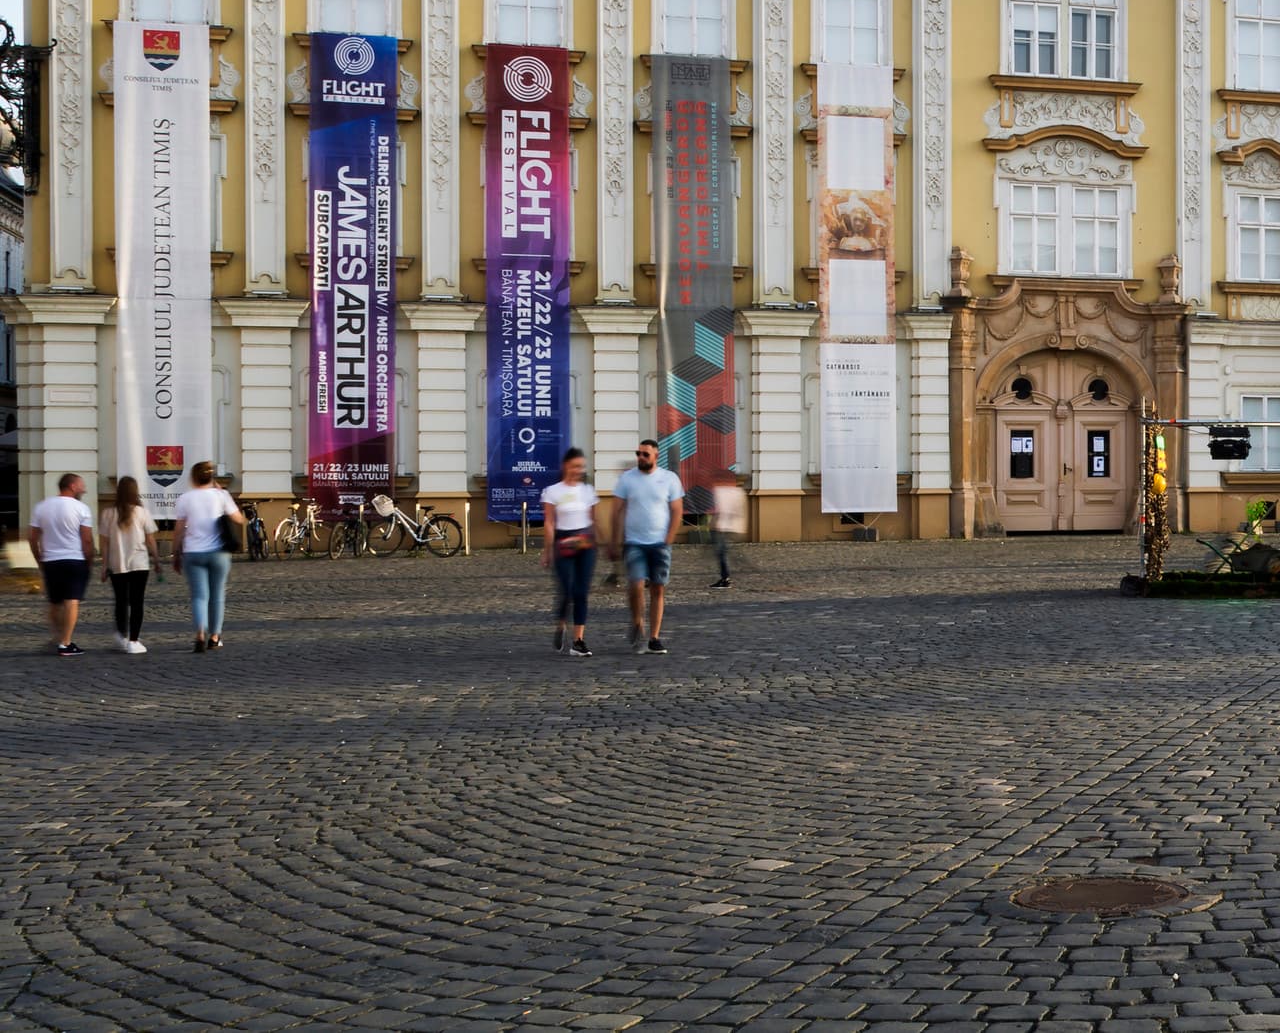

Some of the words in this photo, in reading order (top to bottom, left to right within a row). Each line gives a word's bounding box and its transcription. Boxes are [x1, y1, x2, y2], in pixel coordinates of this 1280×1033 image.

[123, 75, 161, 84] CONSILIUL
[322, 79, 386, 96] FLIGHT
[154, 118, 176, 179] TIMIȘ
[378, 136, 389, 185] DELIRIC
[503, 115, 514, 231] FESTIVAL
[520, 110, 552, 239] FLIGHT
[337, 166, 367, 281] JAMES
[378, 188, 388, 198] X
[378, 199, 388, 241] SILENT
[676, 101, 692, 305] NEOAVANGARDA
[154, 185, 176, 297] JUDEȚEAN
[377, 245, 388, 287] STRIKE
[376, 293, 388, 313] W/
[499, 269, 515, 335] BĂNĂȚEAN
[517, 270, 531, 339] MUZEUL
[533, 271, 553, 359] 21/22/23
[155, 303, 174, 419] CONSILIUL
[336, 286, 366, 426] ARTHUR
[376, 316, 388, 351] MUSE
[318, 351, 327, 382] MARIO
[318, 383, 327, 411] FRESH
[376, 354, 388, 432] ORCHESTRA
[499, 347, 514, 417] TIMIȘOARA
[517, 344, 531, 417] SATULUI
[535, 365, 551, 417] IUNIE
[313, 463, 359, 472] 21/22/23
[361, 464, 390, 472] IUNIE
[313, 472, 350, 480] MUZEUL
[351, 472, 390, 480] SATULUI
